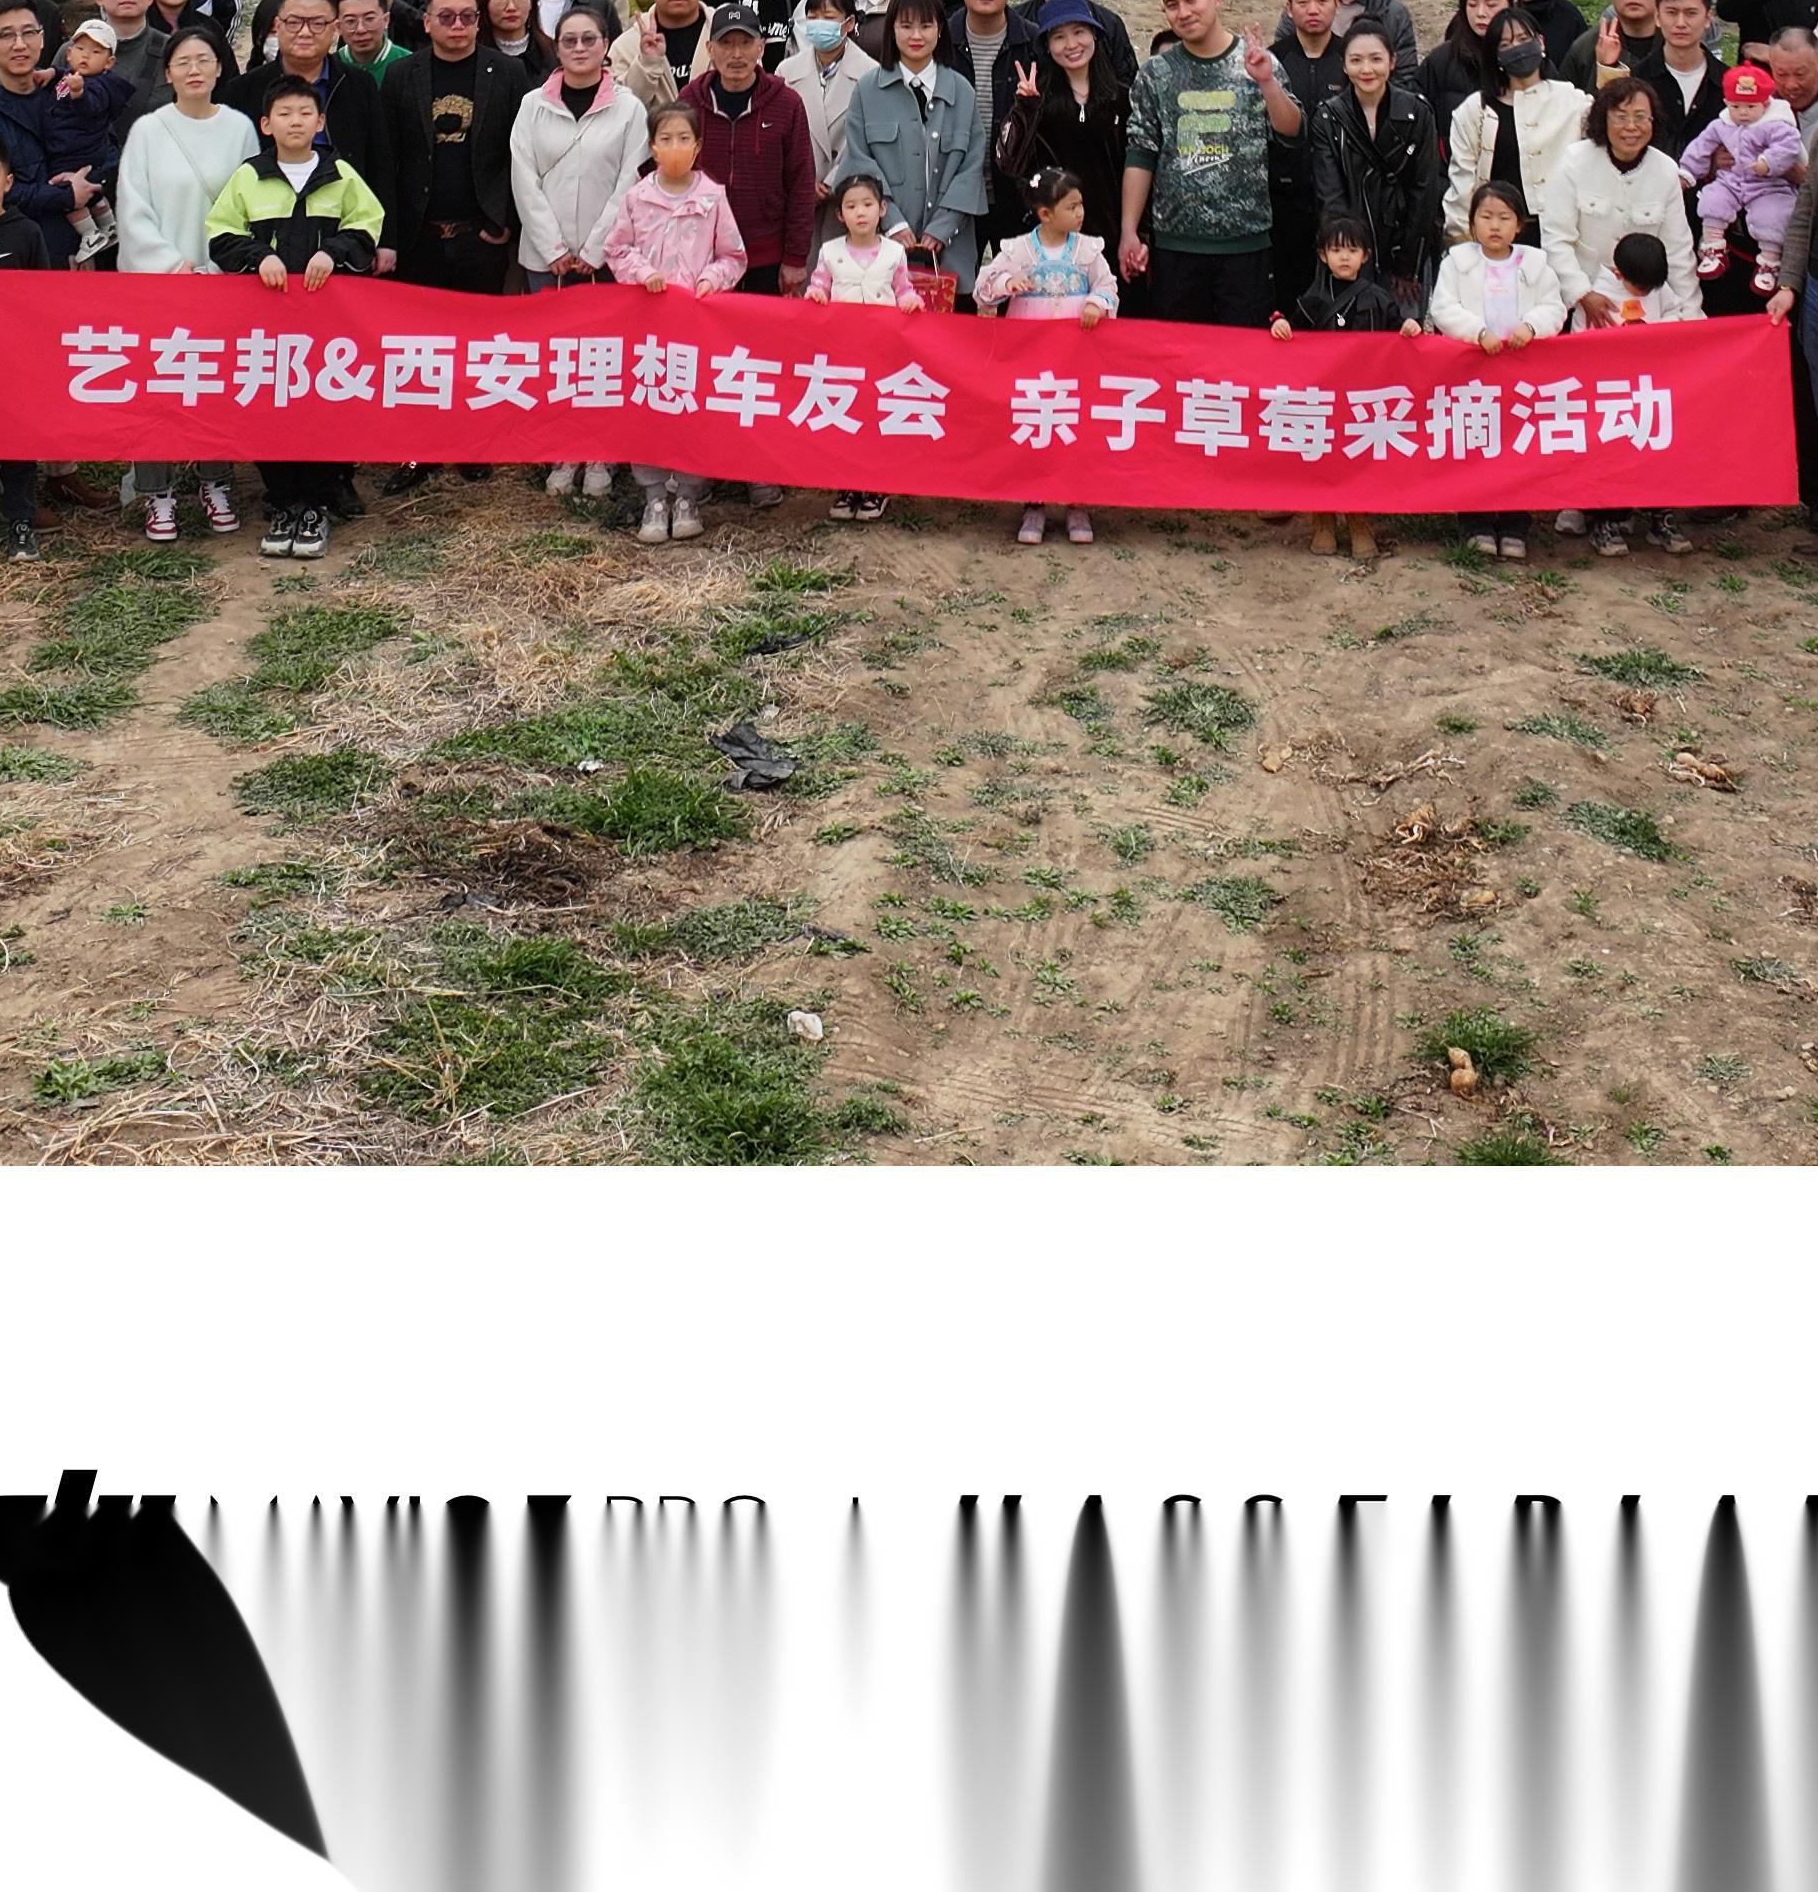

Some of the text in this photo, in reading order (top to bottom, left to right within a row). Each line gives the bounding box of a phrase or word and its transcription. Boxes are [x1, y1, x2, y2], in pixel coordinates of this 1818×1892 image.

[61, 325, 1673, 461] 艺车邦&西安理想车友会 亲子草莓采摘活动
